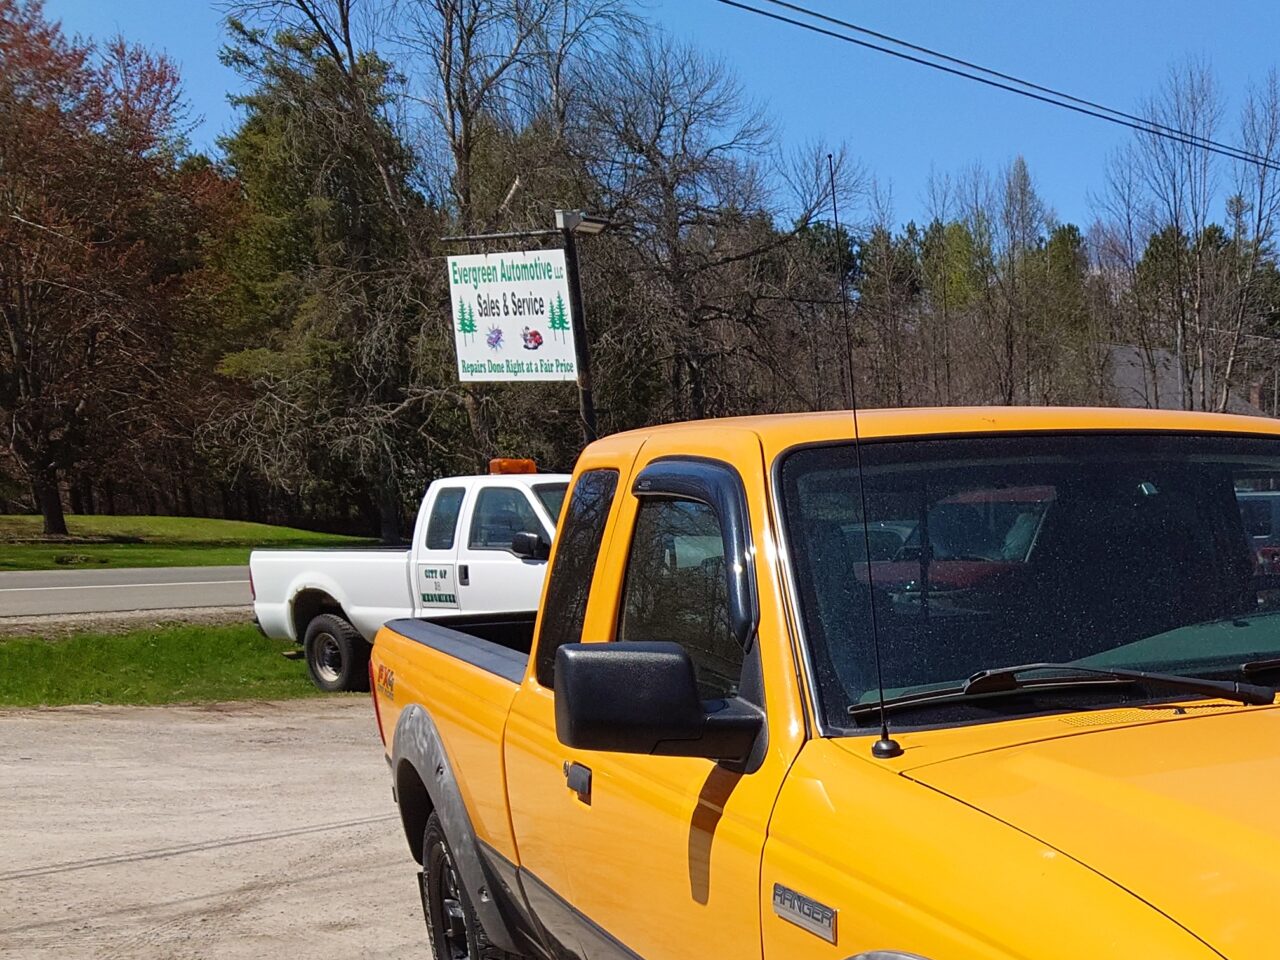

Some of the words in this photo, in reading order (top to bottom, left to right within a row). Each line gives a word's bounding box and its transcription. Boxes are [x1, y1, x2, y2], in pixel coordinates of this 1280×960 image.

[451, 261, 498, 290] Evergreen
[500, 256, 553, 282] Automotive
[553, 265, 564, 279] LLC
[477, 291, 501, 318] Sales
[502, 292, 510, 316] &
[511, 291, 545, 316] Service
[461, 359, 487, 376] Repairs
[487, 359, 505, 373] Done
[505, 358, 525, 376] Right
[525, 360, 534, 373] at
[534, 363, 539, 373] a
[540, 358, 555, 373] Fair
[555, 359, 574, 373] Price
[774, 887, 835, 928] RANGER
